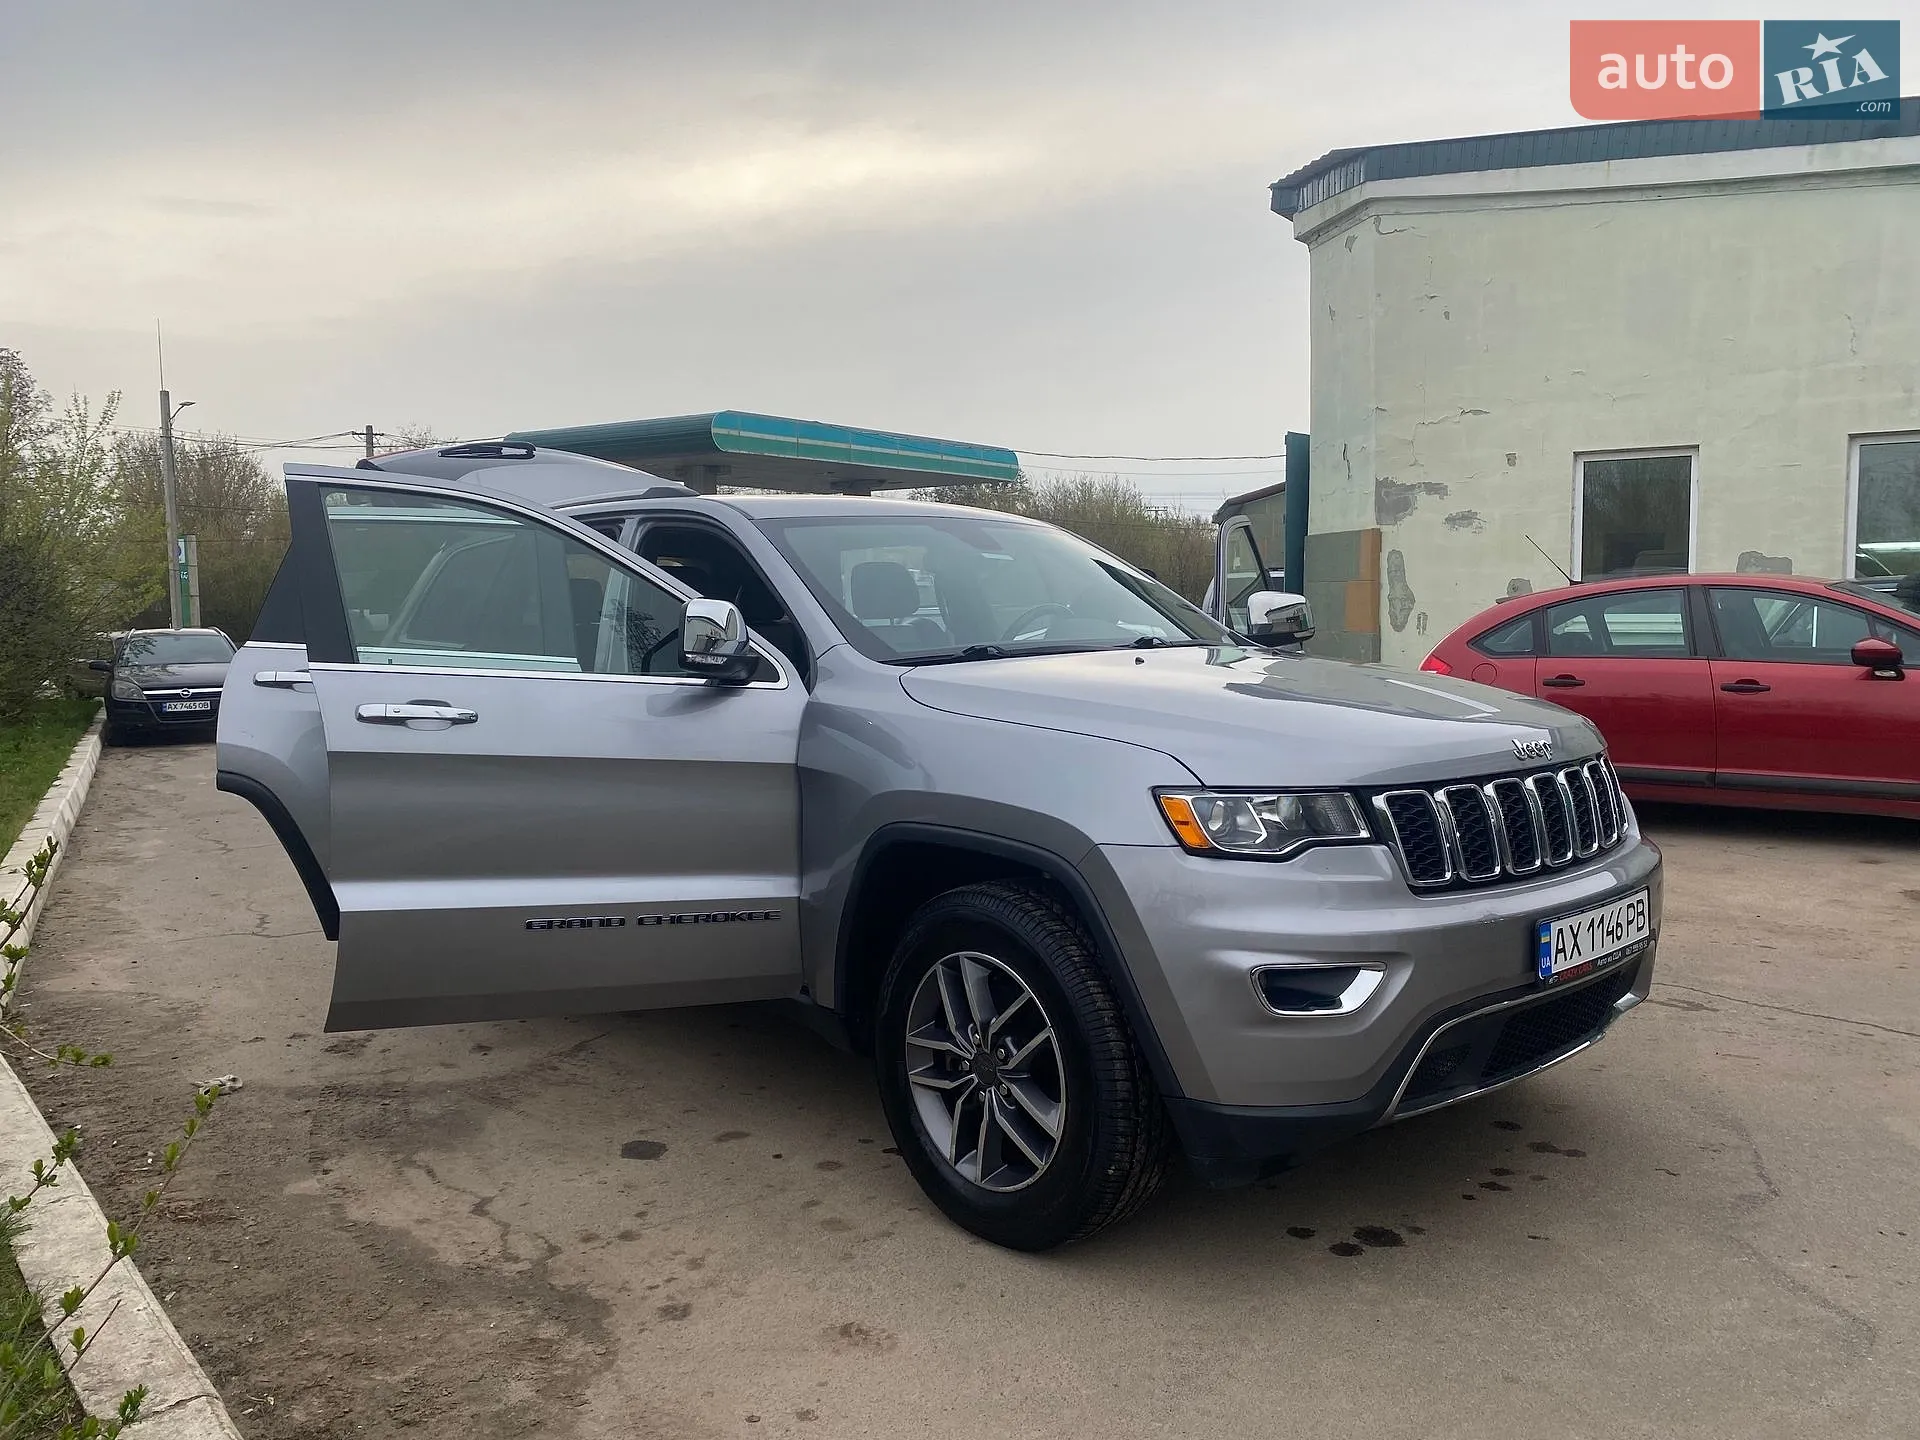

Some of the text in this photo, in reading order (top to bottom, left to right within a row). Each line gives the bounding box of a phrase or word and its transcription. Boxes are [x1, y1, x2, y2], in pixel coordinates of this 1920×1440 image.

[1512, 738, 1552, 760] Jeep
[524, 909, 782, 930] GRAND CHEROKEE
[1553, 898, 1646, 965] AX 1146 PB
[1541, 956, 1551, 969] UA
